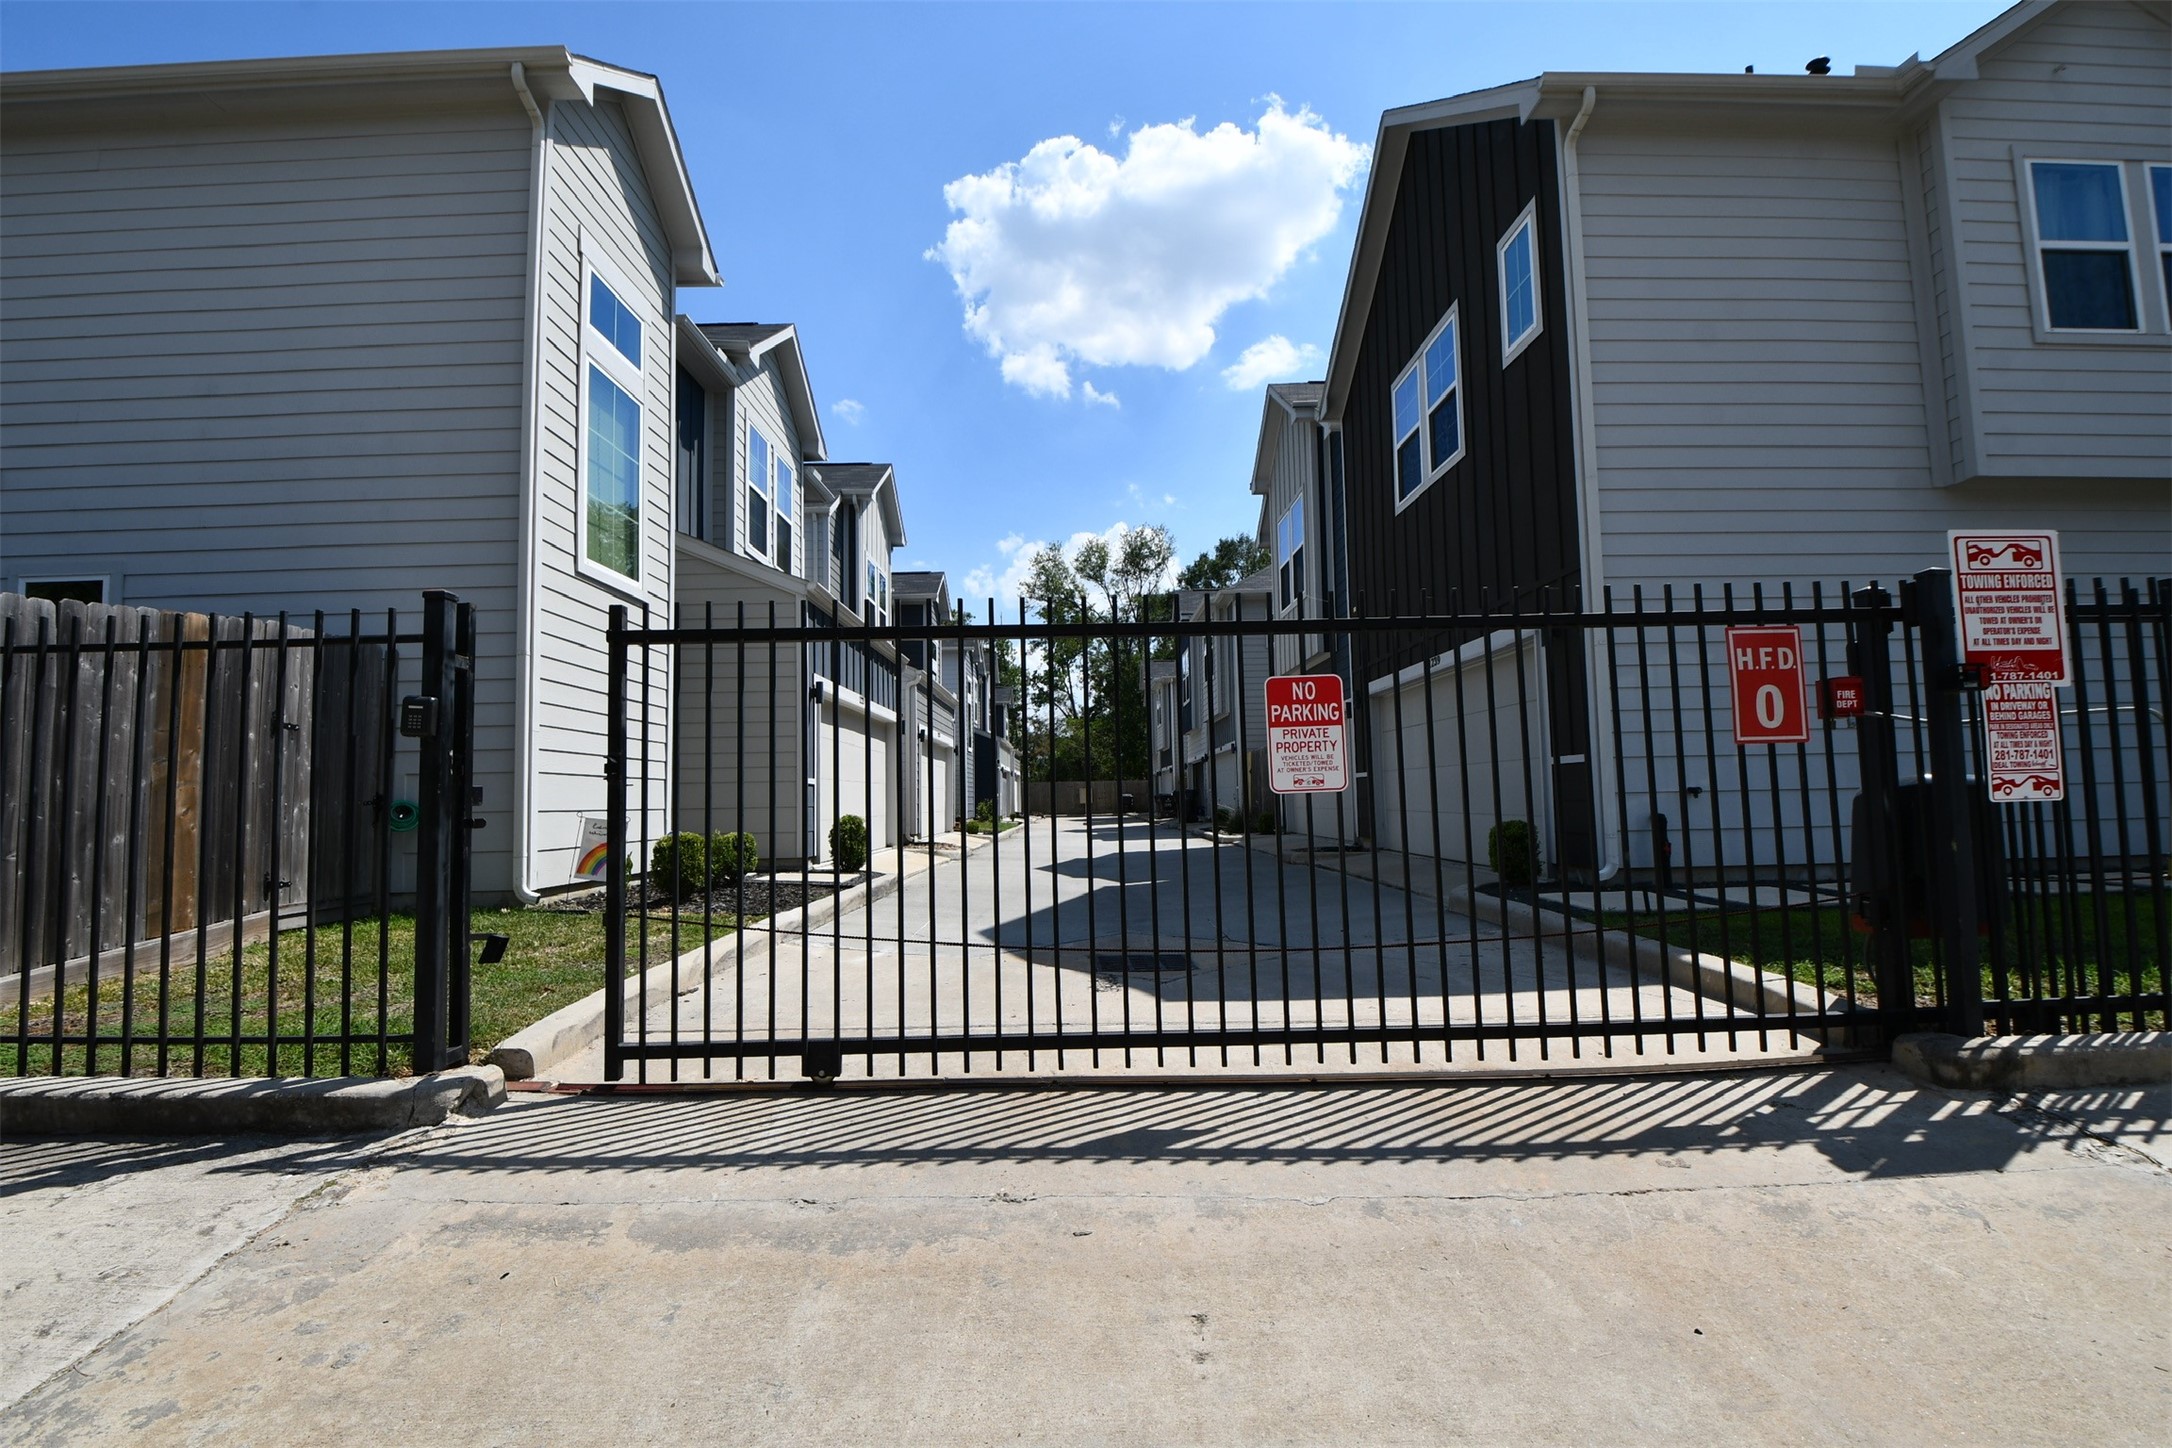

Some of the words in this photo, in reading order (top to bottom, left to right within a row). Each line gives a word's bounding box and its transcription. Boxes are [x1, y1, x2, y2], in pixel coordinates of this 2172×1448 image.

[1960, 574, 2002, 589] TOWING
[2003, 574, 2054, 589] ENFORCED
[1976, 595, 1993, 603] OTHER
[1995, 595, 2020, 603] VEHICLES
[2021, 594, 2053, 603] PROHIBITED
[1983, 627, 2015, 635] OPERATOR'S
[2017, 627, 2041, 635] EXPENSE
[1973, 638, 1980, 646] AT
[1982, 638, 1991, 646] ALL
[2011, 637, 2022, 645] DAY
[2023, 637, 2035, 645] AND
[2036, 637, 2053, 645] NIGHT
[1736, 647, 1797, 670] H.F.D.
[1292, 681, 1316, 700] NO
[1837, 690, 1856, 699] FIRE
[1985, 684, 2000, 700] NO
[2003, 683, 2051, 700] PARKING
[1756, 684, 1785, 729] 0
[1836, 700, 1858, 708] DEPT
[1990, 702, 1999, 711] IN
[2000, 701, 2036, 711] DRIVEWAY
[2038, 701, 2048, 710] OR
[1271, 703, 1340, 722] PARKING
[1990, 711, 2016, 720] BEHIND
[2018, 710, 2051, 720] GARAGES
[1282, 728, 1330, 739] PRIVATE
[2019, 731, 2048, 739] ENFORCED
[1276, 740, 1337, 753] PROPERTY
[1995, 749, 2053, 760] 281-787-1401
